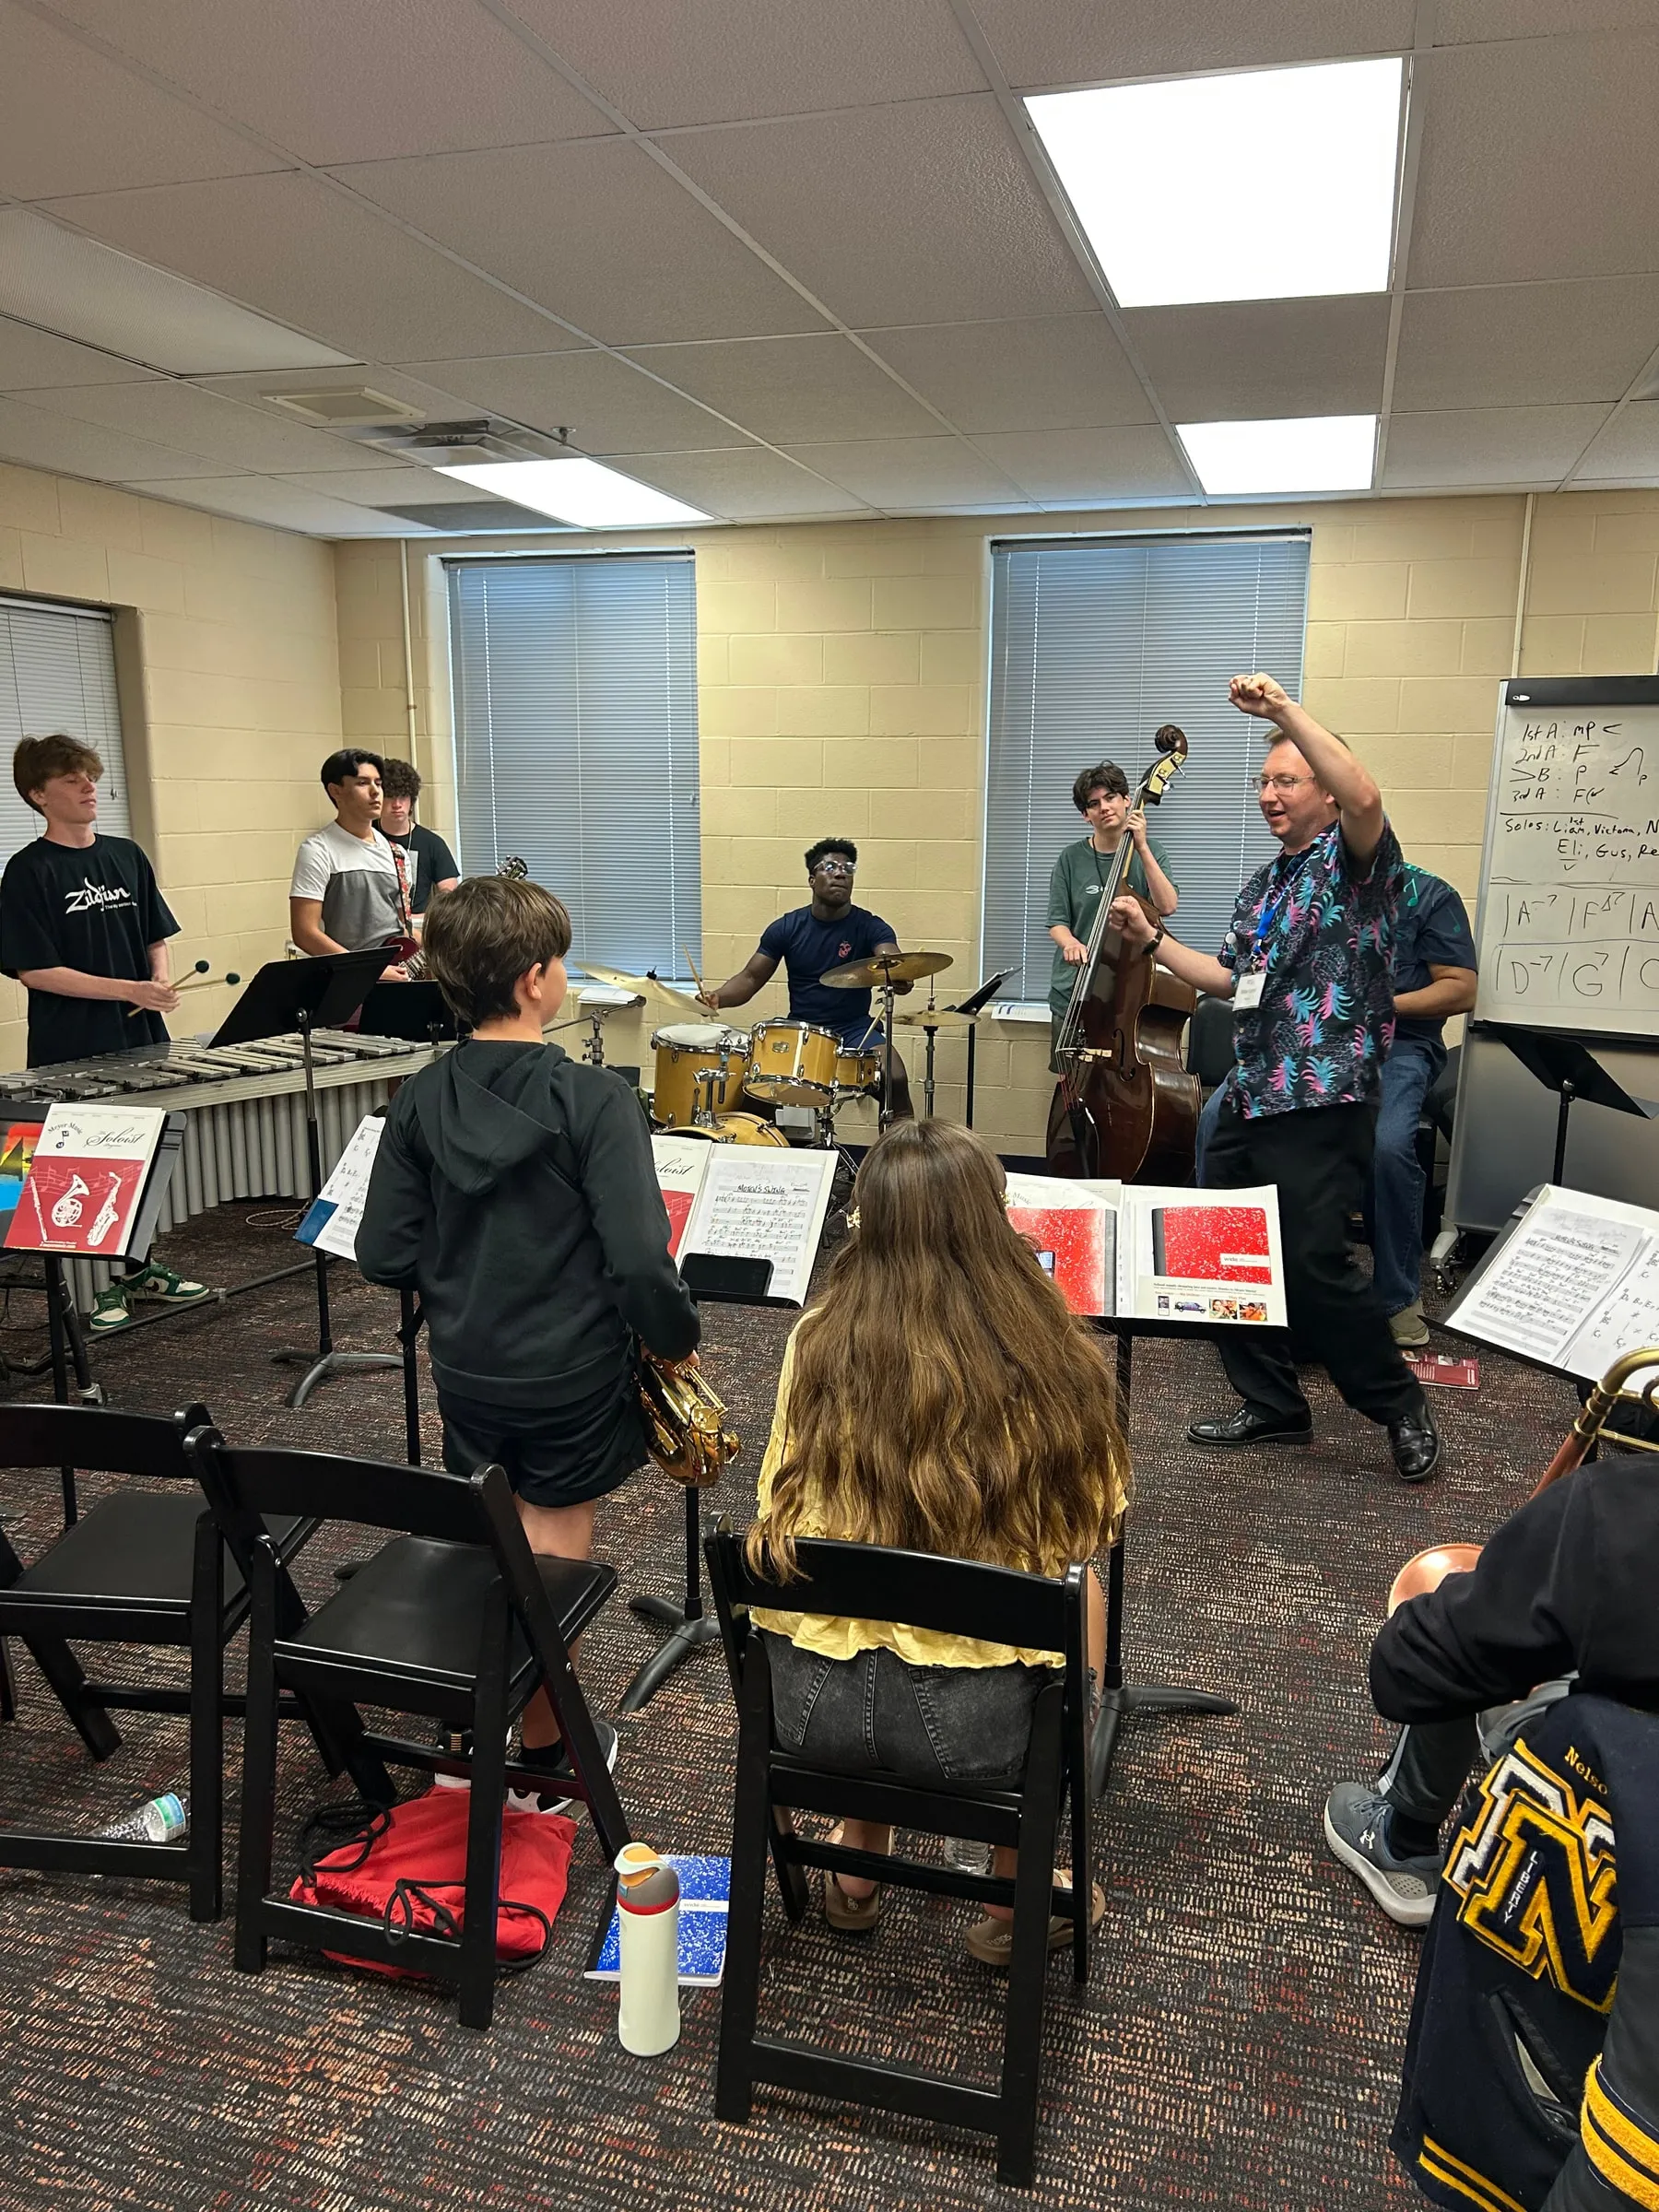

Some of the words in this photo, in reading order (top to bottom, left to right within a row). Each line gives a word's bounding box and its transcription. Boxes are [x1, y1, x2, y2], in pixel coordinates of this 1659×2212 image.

[1523, 724, 1542, 741] 1st
[1515, 746, 1542, 764] 2nd
[65, 877, 131, 914] Zildjian
[48, 1124, 67, 1135] Meyer
[68, 1122, 83, 1135] Music
[83, 1126, 146, 1147] Soloist
[1504, 1850, 1540, 1924] LIBERTY
